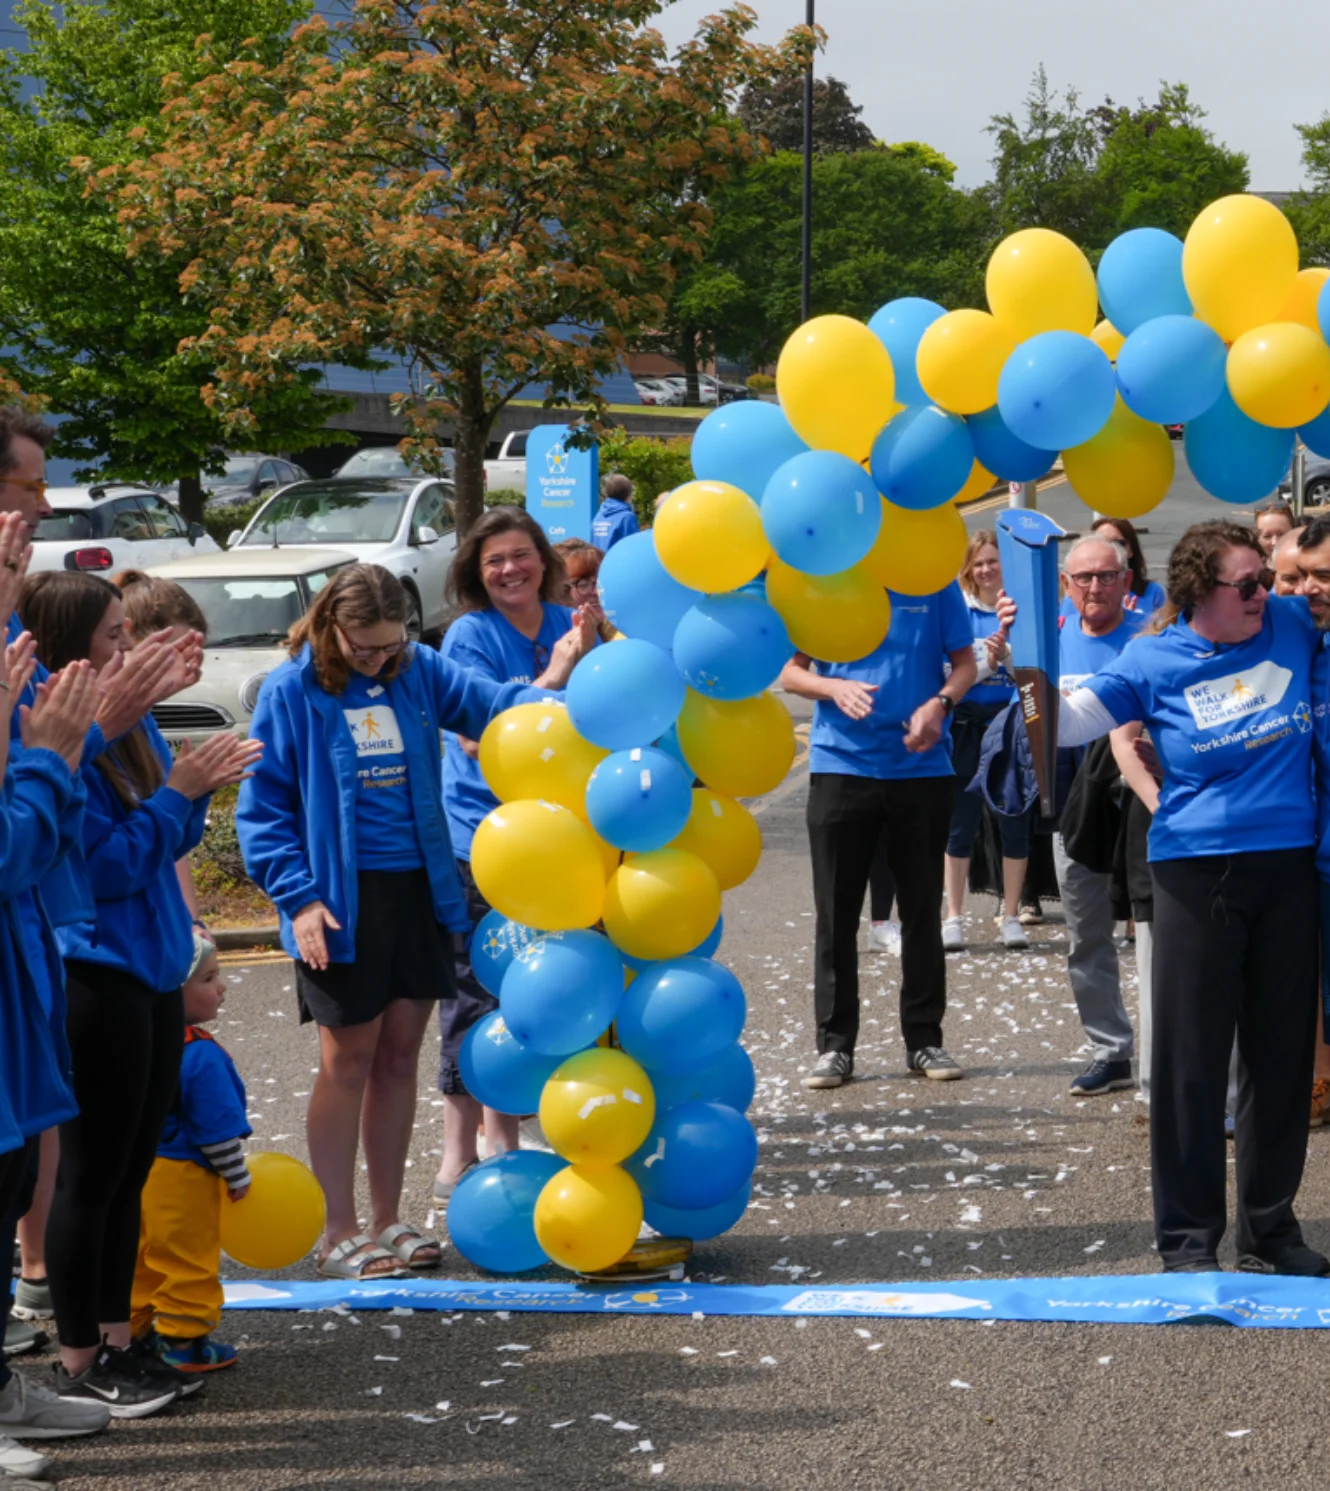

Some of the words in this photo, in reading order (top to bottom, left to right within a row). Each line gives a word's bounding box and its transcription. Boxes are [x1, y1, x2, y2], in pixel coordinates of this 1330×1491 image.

[539, 476, 577, 487] Yorkshire
[543, 487, 572, 497] Cancer
[1191, 685, 1211, 699] WE
[1196, 692, 1228, 706] WALK
[1198, 704, 1223, 714] FOR
[1201, 694, 1268, 723] YORKSHIRE
[1191, 732, 1250, 753] Yorkshire
[1250, 714, 1290, 735] Cancer
[1245, 727, 1294, 750] Research
[371, 765, 407, 777] Cancer
[363, 776, 408, 789] Research
[492, 1289, 600, 1300] Cancer
[1047, 1298, 1192, 1311] Yorkshire
